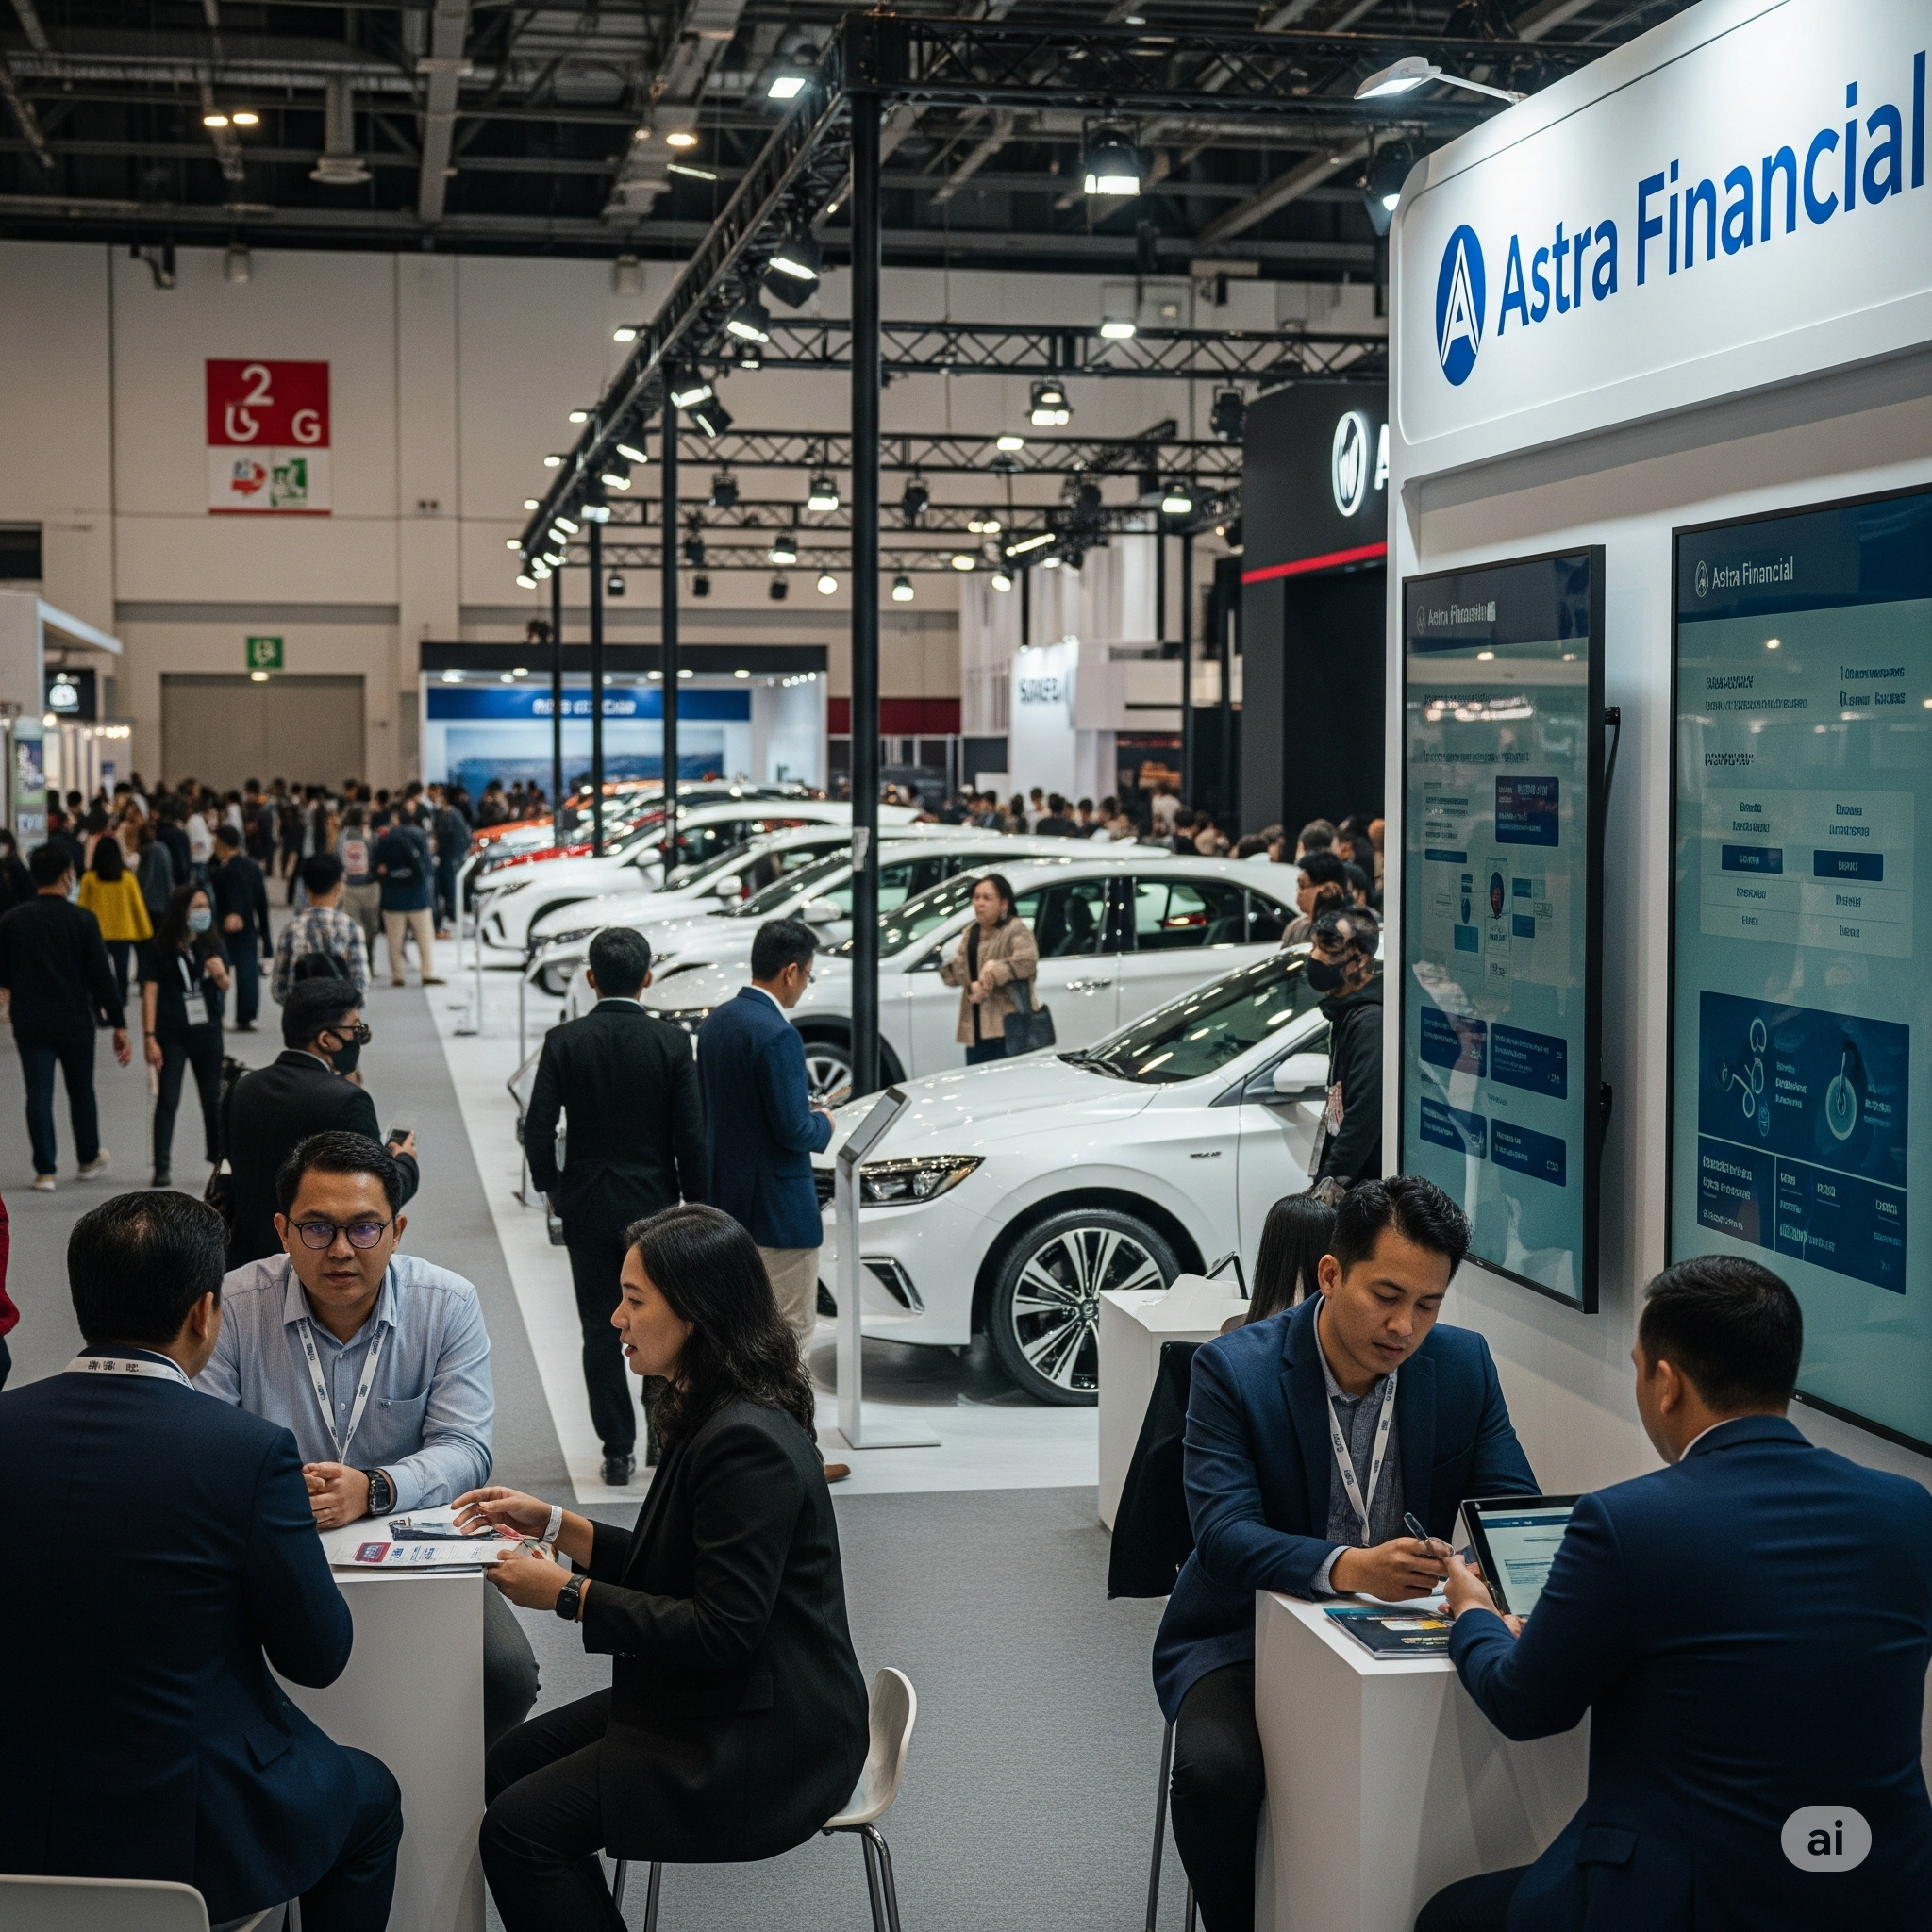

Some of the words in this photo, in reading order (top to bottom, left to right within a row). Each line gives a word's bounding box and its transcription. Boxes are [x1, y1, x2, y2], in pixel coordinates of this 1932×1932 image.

[1497, 219, 1618, 337] Astra
[1637, 50, 1926, 287] Financial
[241, 363, 275, 407] 2
[291, 408, 322, 444] G
[1742, 555, 1793, 585] Financial
